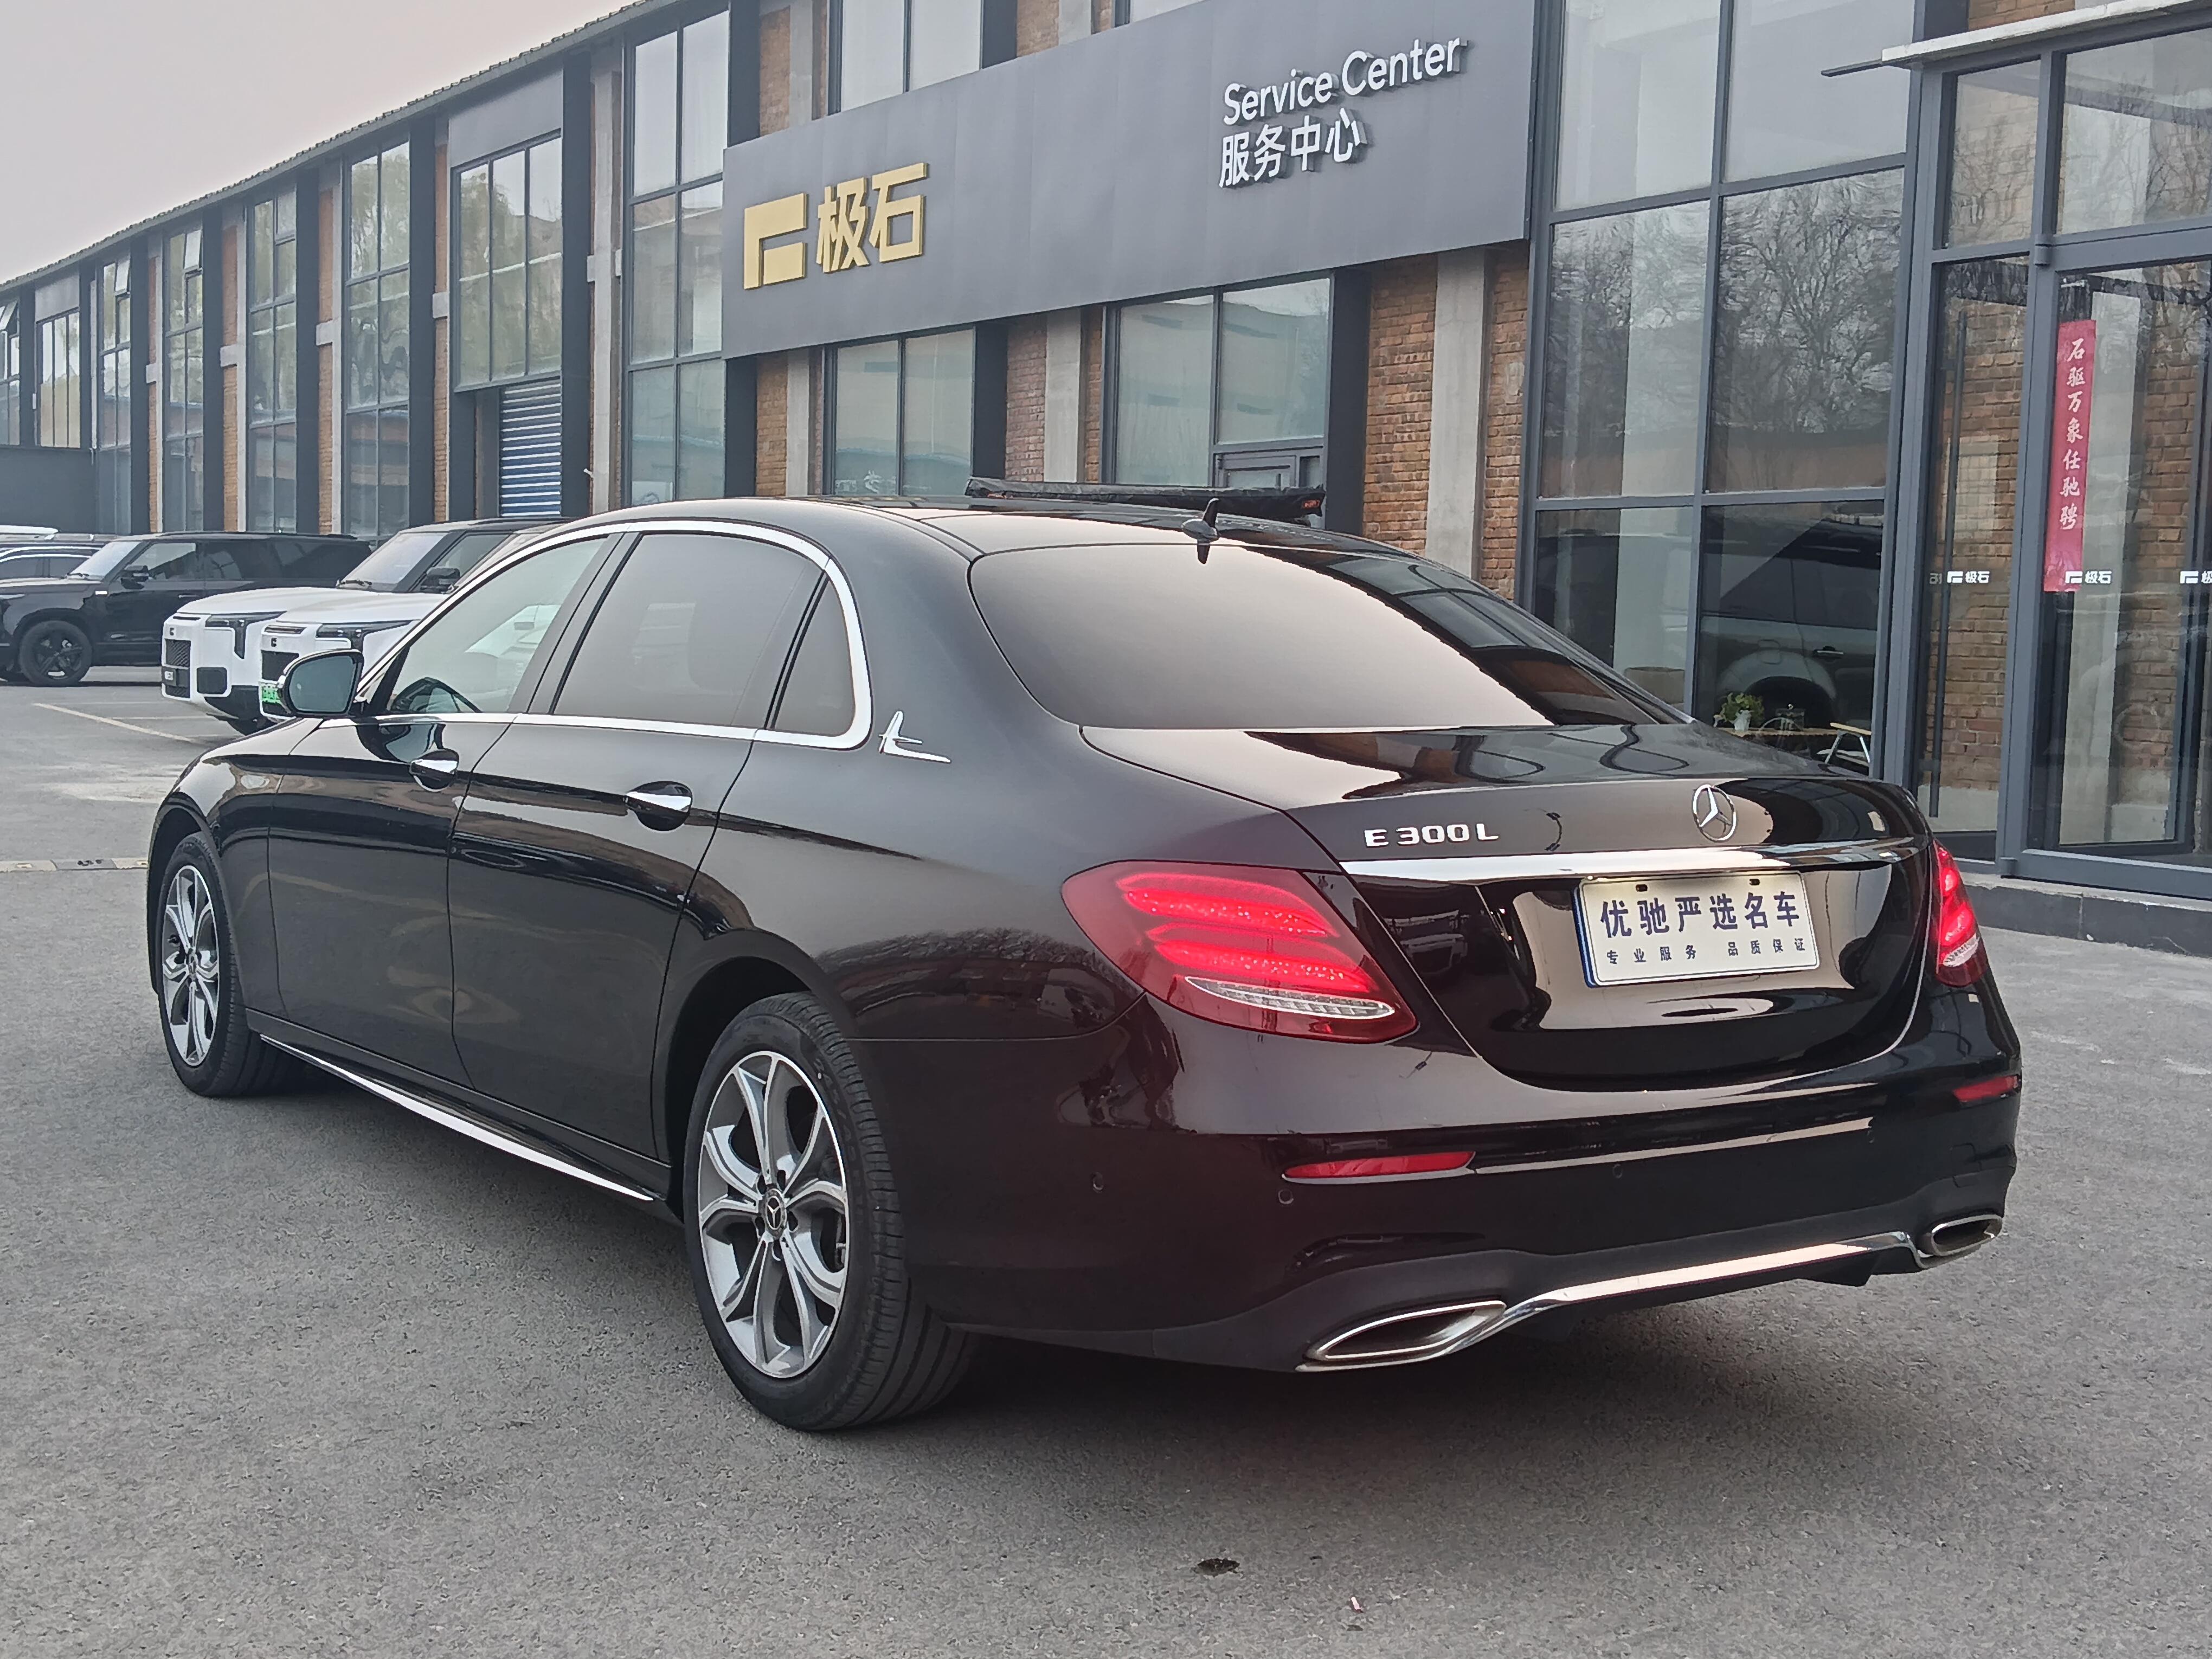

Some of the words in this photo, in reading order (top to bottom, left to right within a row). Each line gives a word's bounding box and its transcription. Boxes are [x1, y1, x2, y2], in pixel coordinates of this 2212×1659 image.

[1223, 68, 1334, 125] Service
[1342, 37, 1468, 95] Center
[1219, 108, 1363, 188] 服务中心
[816, 162, 928, 273] 极石
[1965, 570, 1990, 583] 极石
[2085, 571, 2112, 584] 极石
[1600, 891, 1799, 938] 优驰严选名车
[1606, 944, 1697, 964] 专业服务
[1728, 937, 1805, 956] 品质保证
